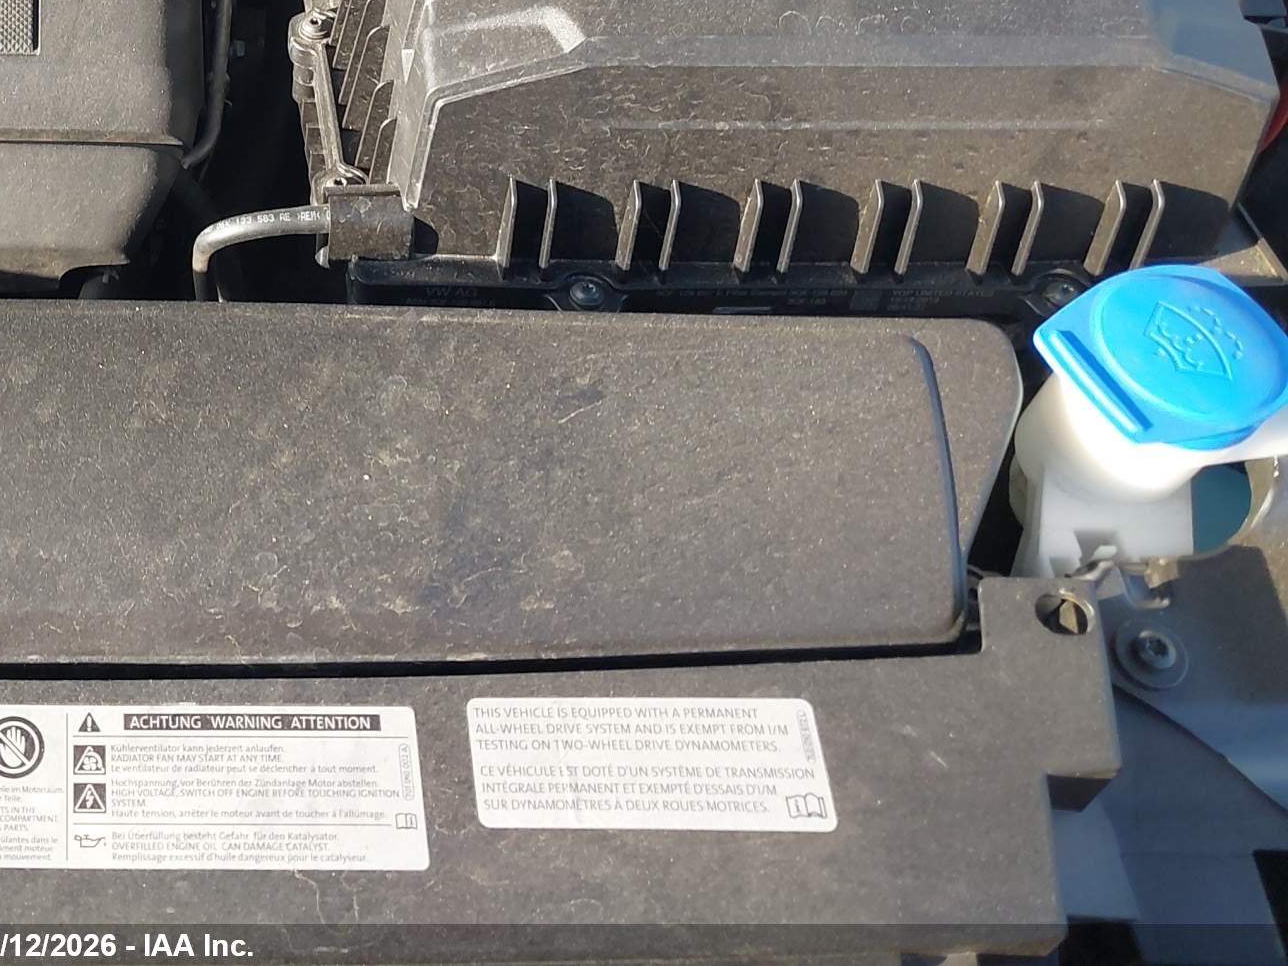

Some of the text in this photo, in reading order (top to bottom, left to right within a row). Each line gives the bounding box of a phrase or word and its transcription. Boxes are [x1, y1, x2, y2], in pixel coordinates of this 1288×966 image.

[474, 707, 501, 718] THIS
[503, 706, 554, 718] VEHICLE
[556, 706, 568, 719] IS
[570, 706, 633, 719] EQUIPPED
[634, 707, 669, 718] WITH
[671, 707, 680, 718] A
[129, 715, 371, 730] ACHTUNG WARNING ATTENTION
[474, 722, 789, 735] ALL-WHEEL DRIVE SYSTEM AND IS EXEMPT FROM I/M
[476, 739, 528, 750] TESTING
[530, 739, 551, 750] ON
[633, 739, 671, 751] DRIVE
[226, 754, 236, 762] AT
[479, 765, 495, 777] CE
[496, 765, 556, 777] VÉHICULE
[581, 765, 614, 777] DOTÉ
[650, 765, 702, 778] SYSTÈME
[704, 766, 721, 778] DE
[724, 766, 815, 779] TRANSMISSION
[481, 781, 545, 793] INTÉGRALE
[621, 782, 636, 794] ET
[637, 782, 690, 794] EXEMPTÉ
[483, 798, 508, 810] SUR
[624, 799, 659, 810] DEUX
[661, 799, 704, 811] ROUES
